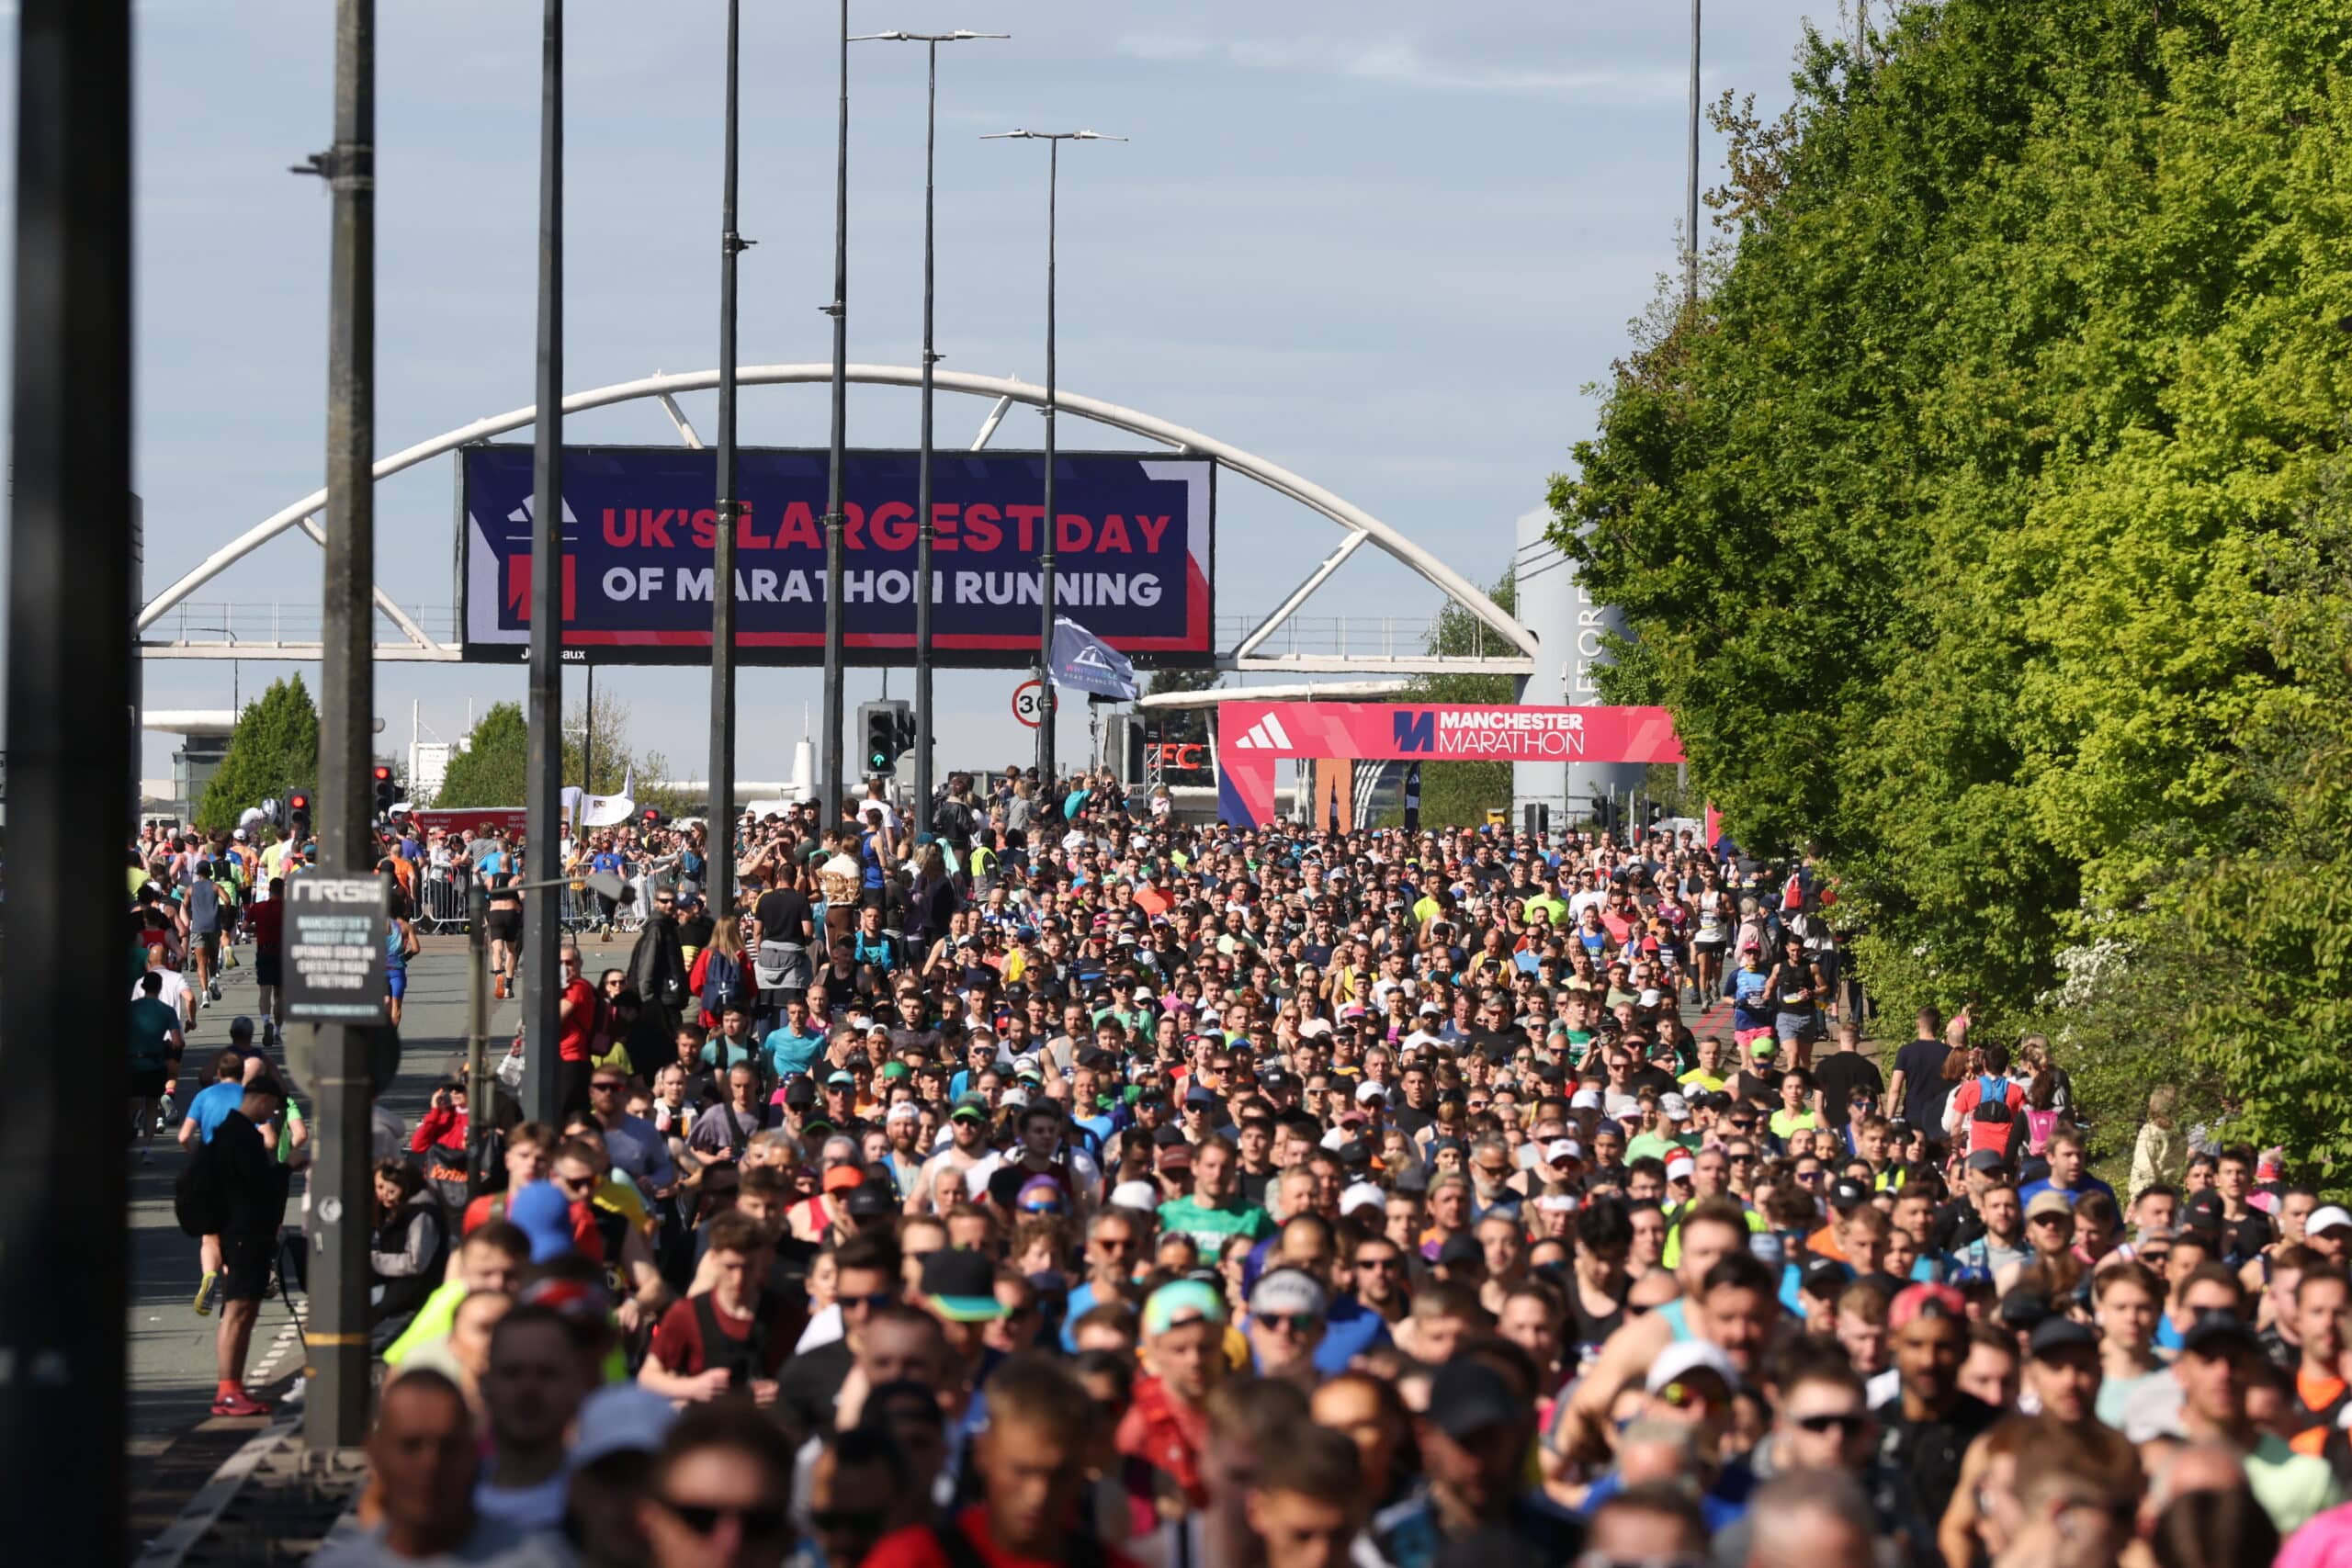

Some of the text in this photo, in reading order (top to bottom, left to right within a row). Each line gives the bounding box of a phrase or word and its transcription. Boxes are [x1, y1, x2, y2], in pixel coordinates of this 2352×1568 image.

[736, 501, 1046, 551] LARGEST
[1056, 513, 1171, 553] DAY
[603, 566, 664, 602] OF
[956, 570, 1162, 607] RUNNING
[1440, 712, 1584, 731] MANCHESTER
[1440, 731, 1585, 755] MARATHON
